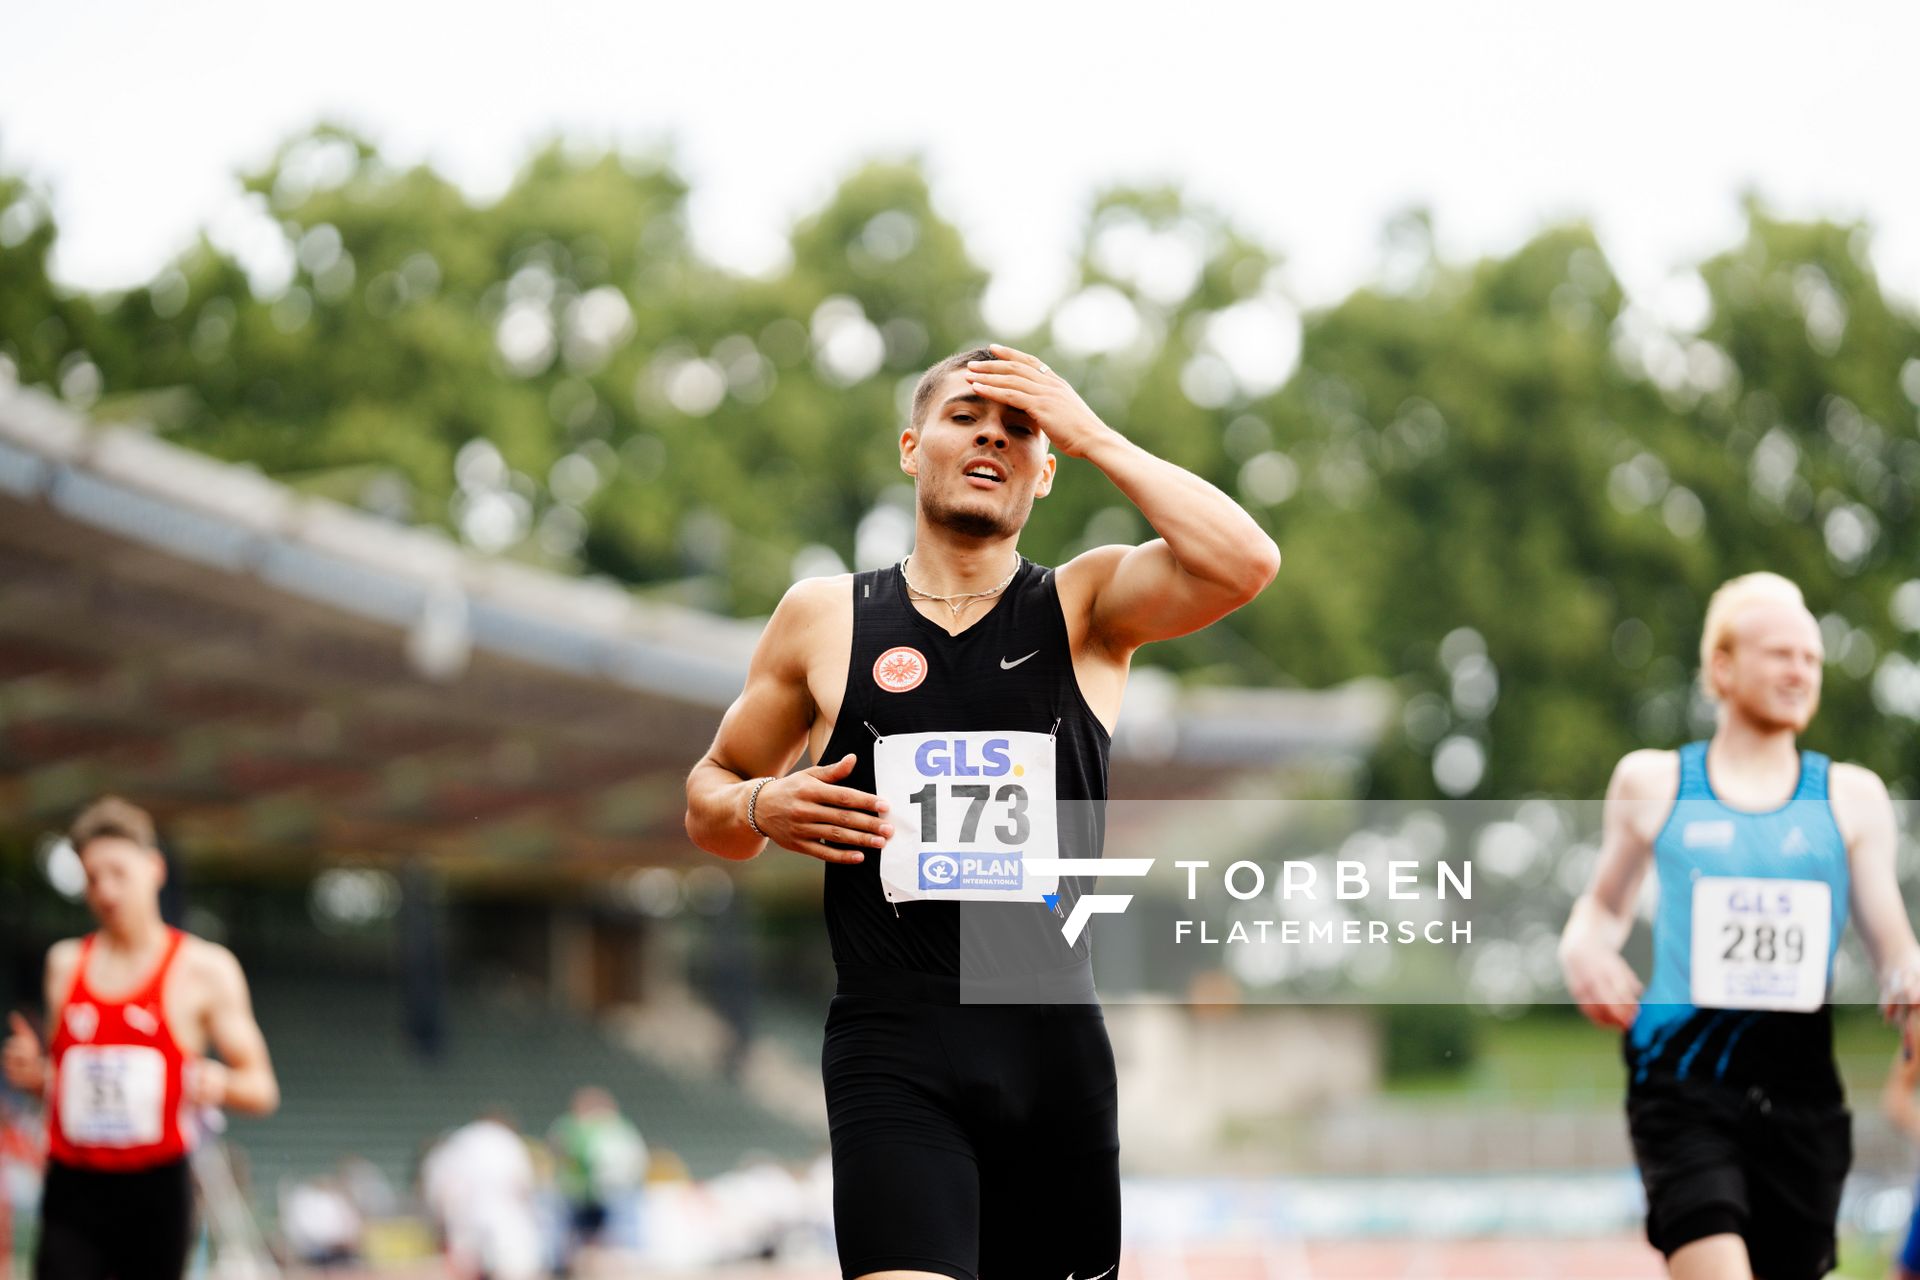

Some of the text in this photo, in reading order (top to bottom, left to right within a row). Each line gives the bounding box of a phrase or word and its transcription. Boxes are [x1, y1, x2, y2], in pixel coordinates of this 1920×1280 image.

[909, 783, 1031, 846] 173
[962, 858, 1019, 877] PLAN
[962, 878, 1019, 886] INTERNATIONAL
[1721, 923, 1805, 964] 289
